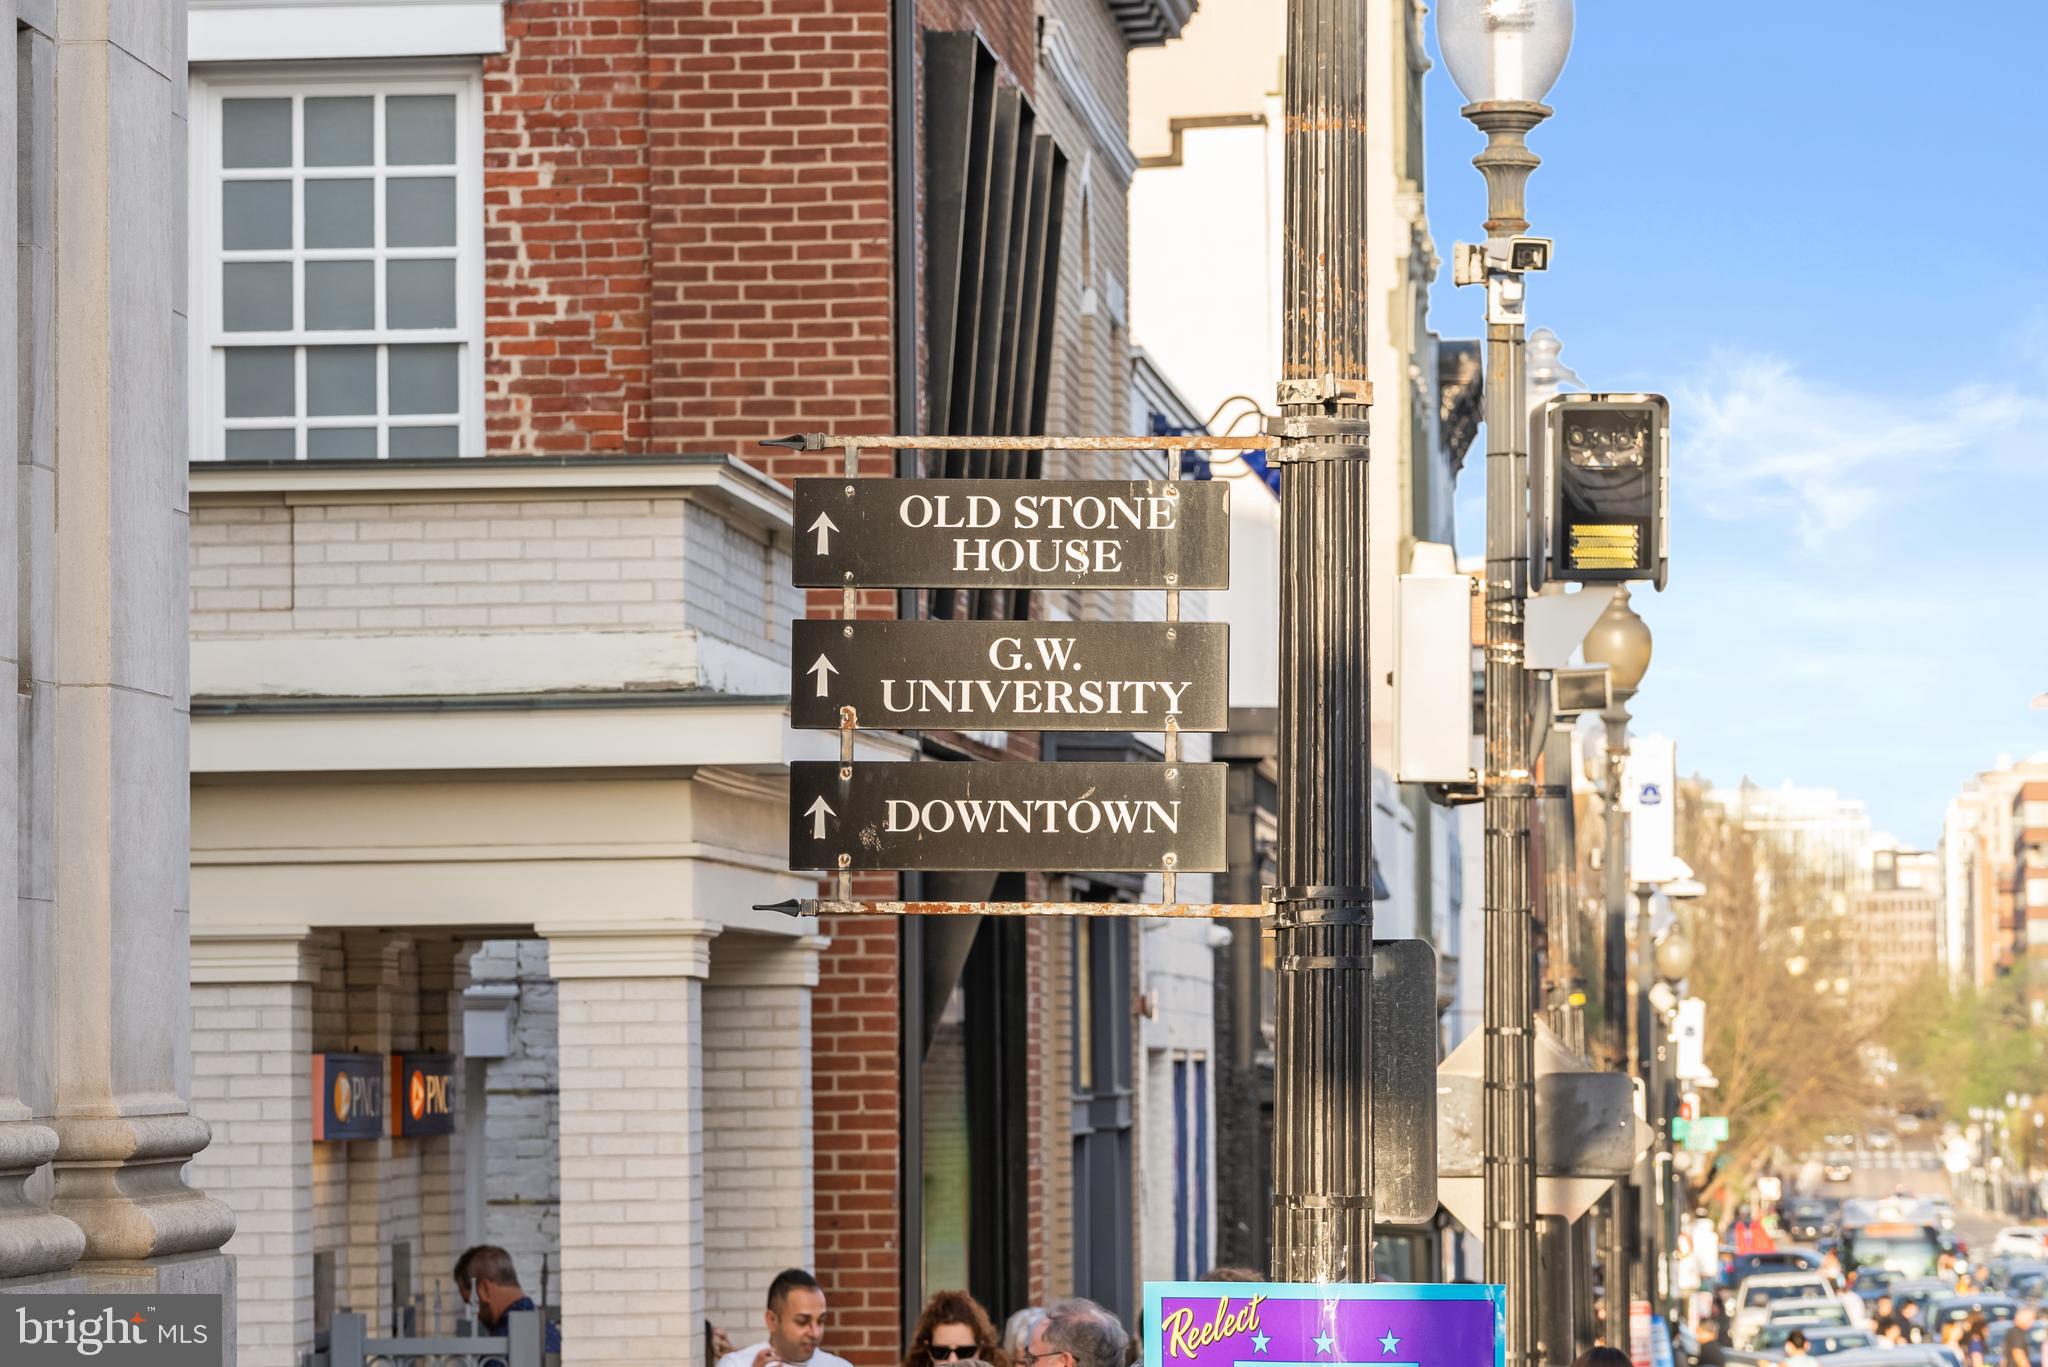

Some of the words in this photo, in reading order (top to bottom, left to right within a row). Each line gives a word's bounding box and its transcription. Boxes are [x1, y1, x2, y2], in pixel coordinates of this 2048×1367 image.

[899, 494, 1001, 529] OLD
[1014, 496, 1177, 531] STONE
[952, 538, 1123, 573] HOUSE
[988, 637, 1083, 671] G.W.
[881, 679, 1193, 715] UNIVERSITY
[884, 799, 1182, 834] DOWNTOWN
[1161, 1293, 1268, 1359] Reelect
